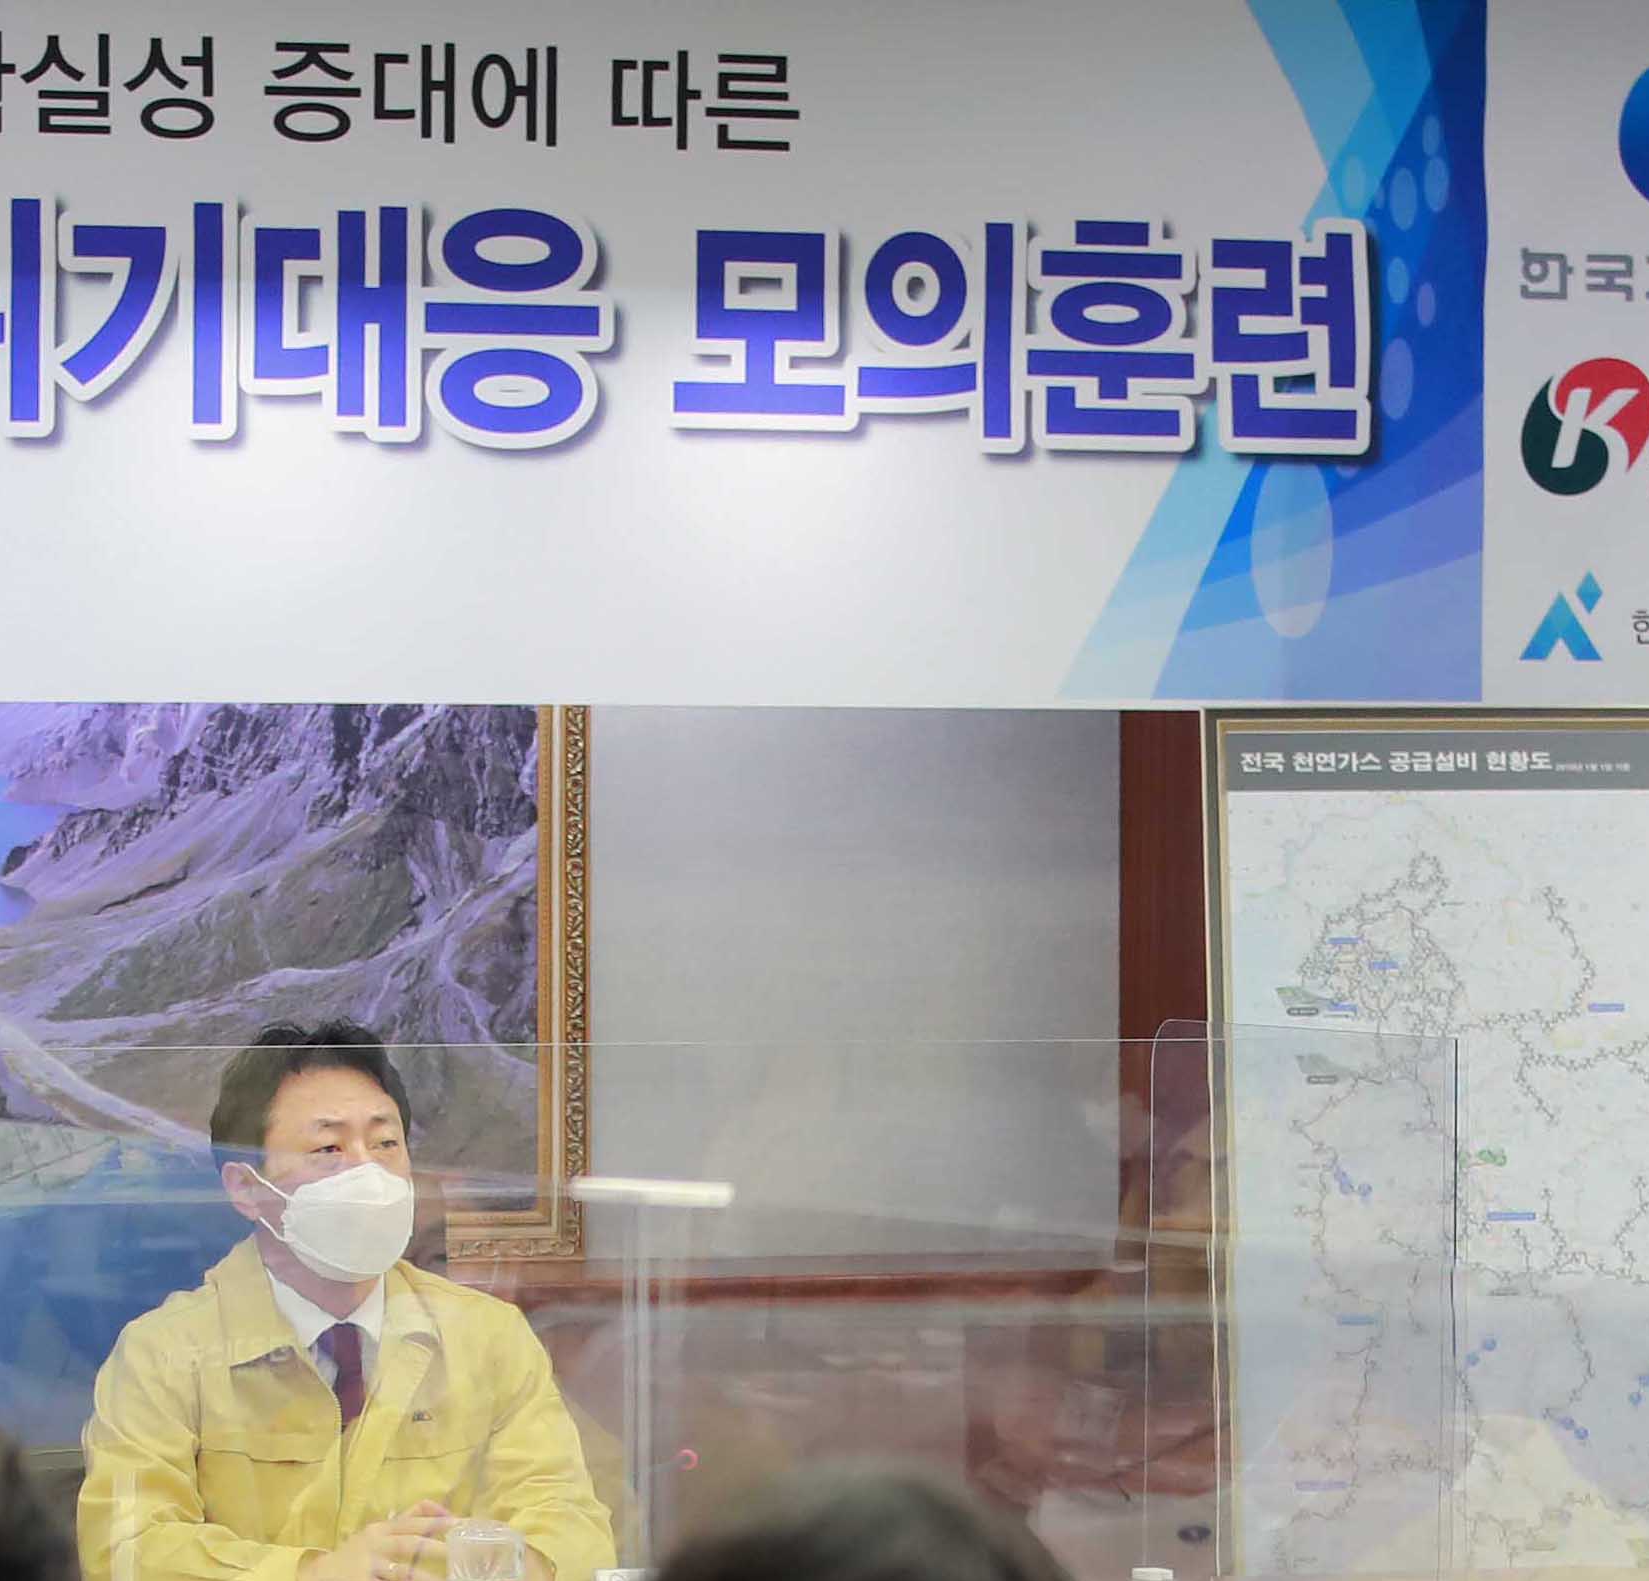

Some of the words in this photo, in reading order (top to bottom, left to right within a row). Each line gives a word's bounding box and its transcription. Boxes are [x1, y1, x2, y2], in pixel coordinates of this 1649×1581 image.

[263, 41, 559, 147] 증대에
[610, 49, 801, 152] 따른
[672, 217, 1359, 443] 모의훈련
[1239, 750, 1285, 773] 전국
[1291, 750, 1383, 773] 천연가스
[1388, 750, 1478, 773] 공급설비
[1485, 750, 1553, 773] 현황도
